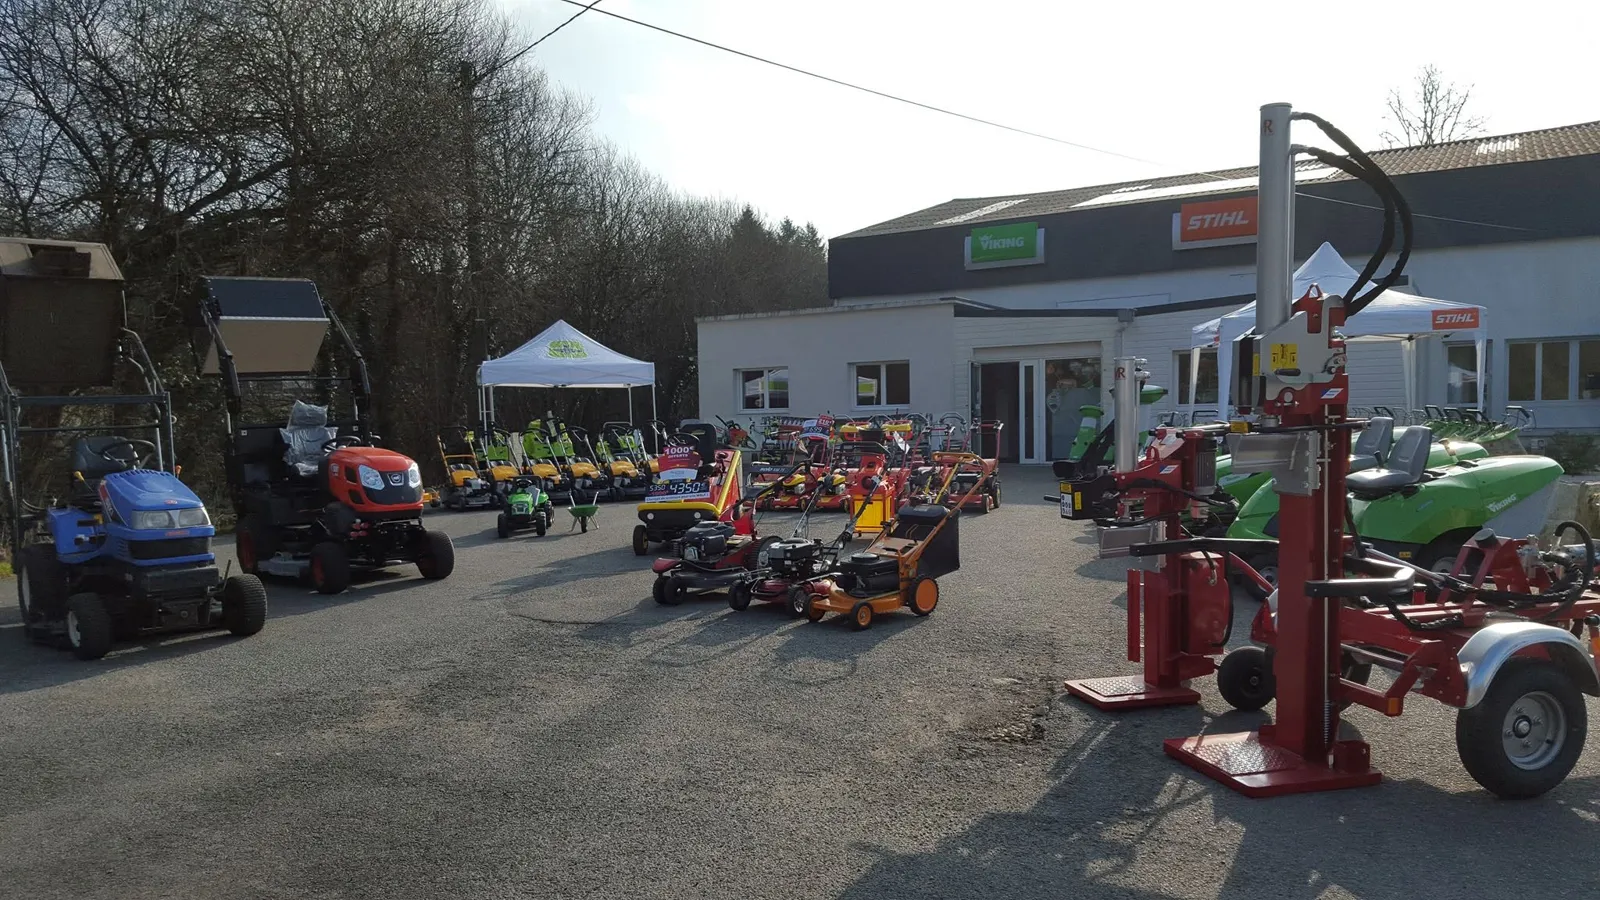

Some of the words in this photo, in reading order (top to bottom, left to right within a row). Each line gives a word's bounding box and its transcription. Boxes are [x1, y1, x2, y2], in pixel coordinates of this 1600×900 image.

[1187, 211, 1249, 230] STIHL
[980, 236, 1024, 250] VIKING
[1435, 313, 1474, 324] STIHL
[1486, 493, 1517, 512] VIKING
